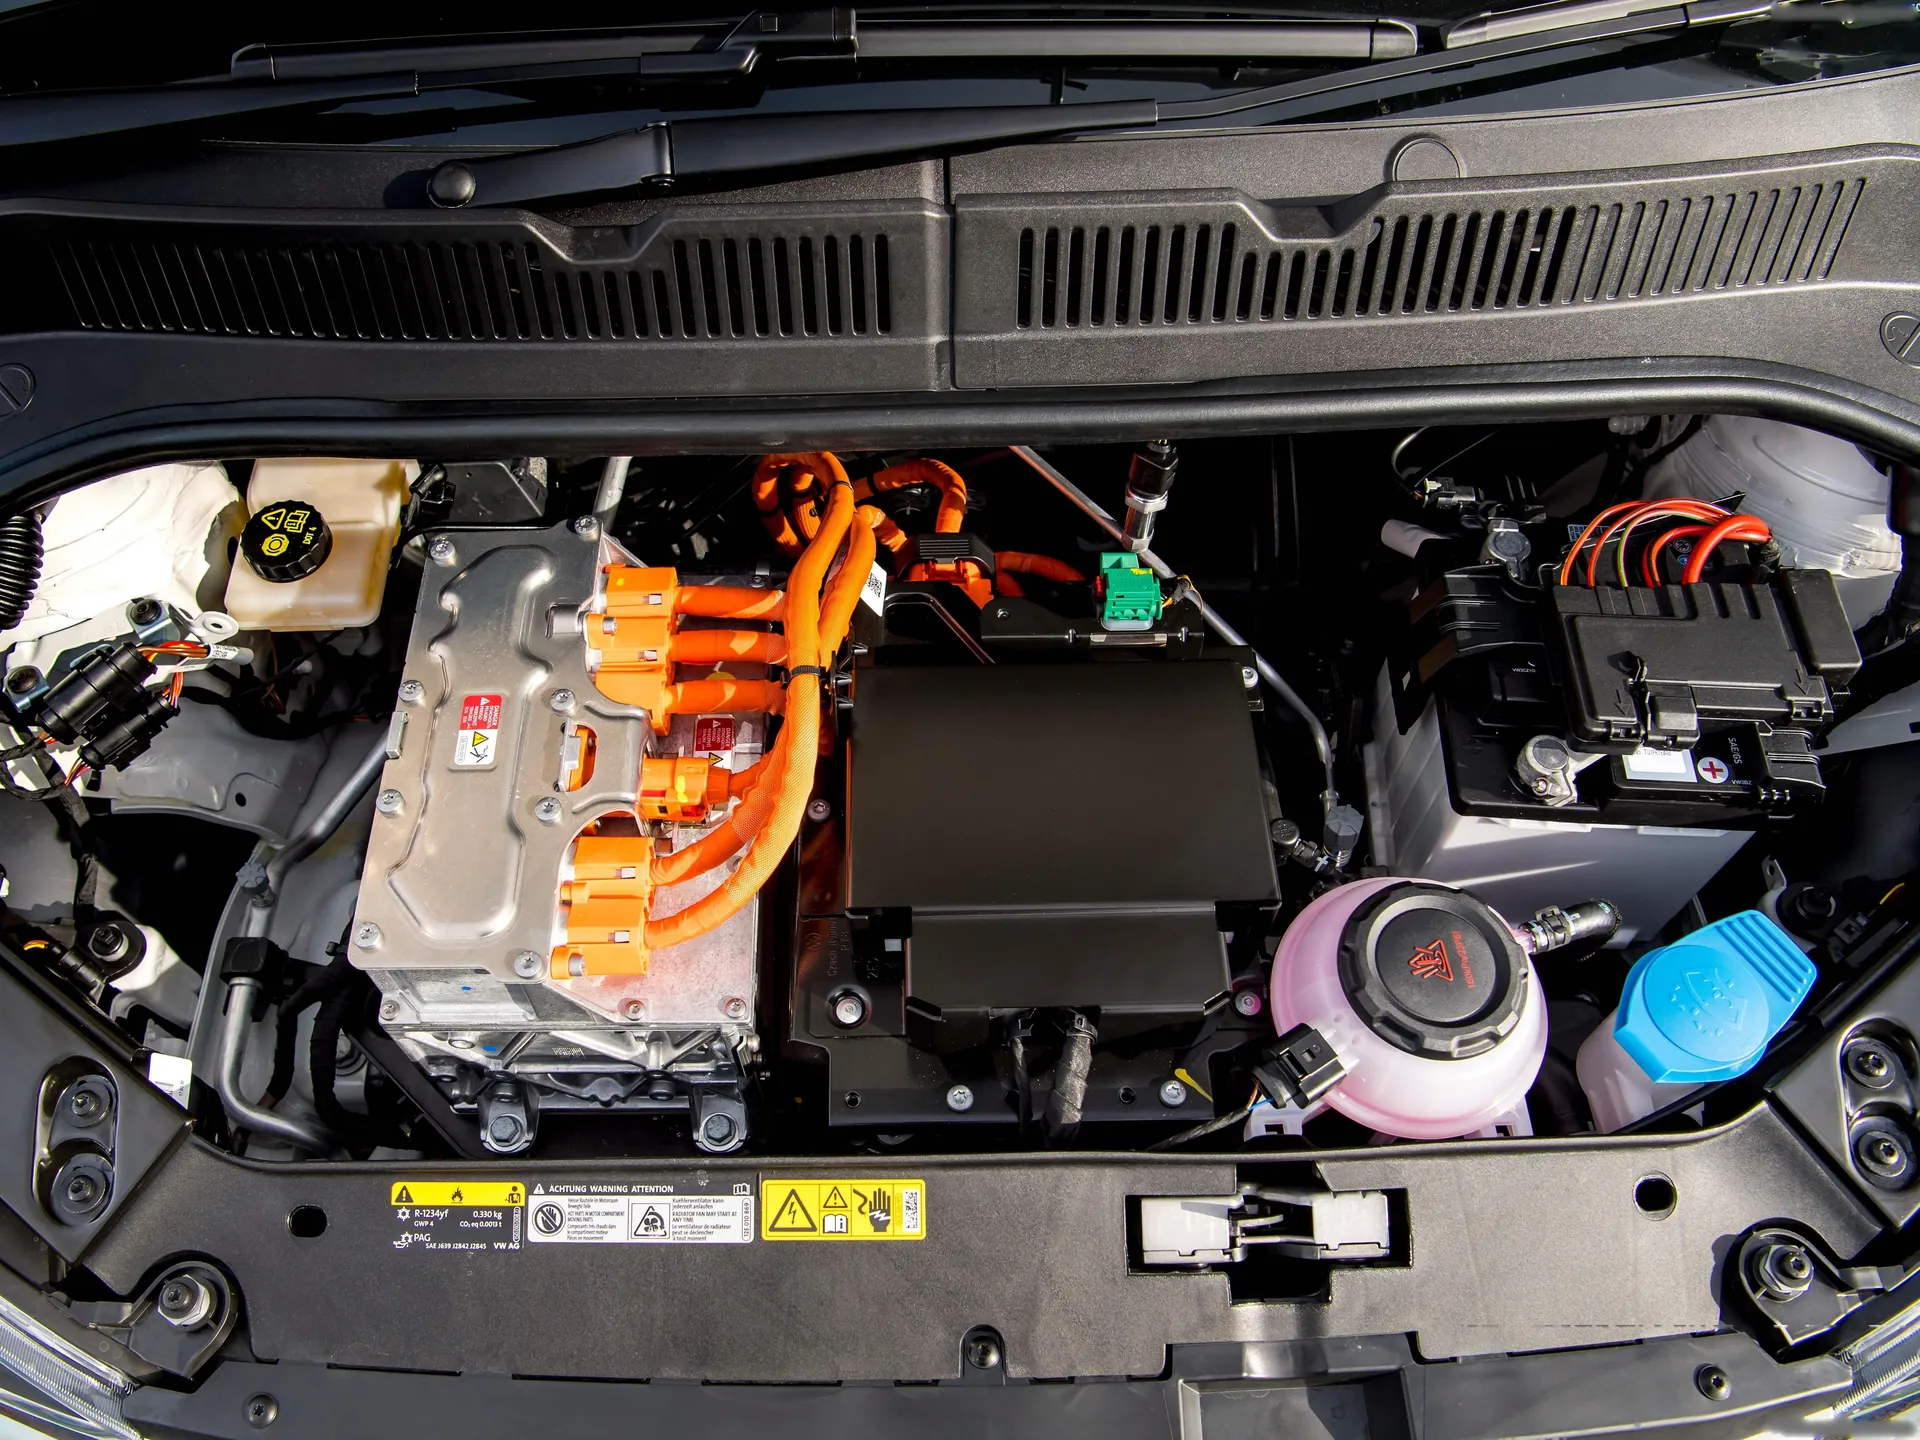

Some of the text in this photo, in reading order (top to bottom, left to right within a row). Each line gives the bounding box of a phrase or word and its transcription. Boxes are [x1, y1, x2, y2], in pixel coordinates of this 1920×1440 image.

[302, 532, 314, 545] DOT
[549, 1184, 674, 1193] ACHTUNG WARNING ATTENTION
[414, 1209, 448, 1219] R-1234yf
[493, 1211, 502, 1219] kg
